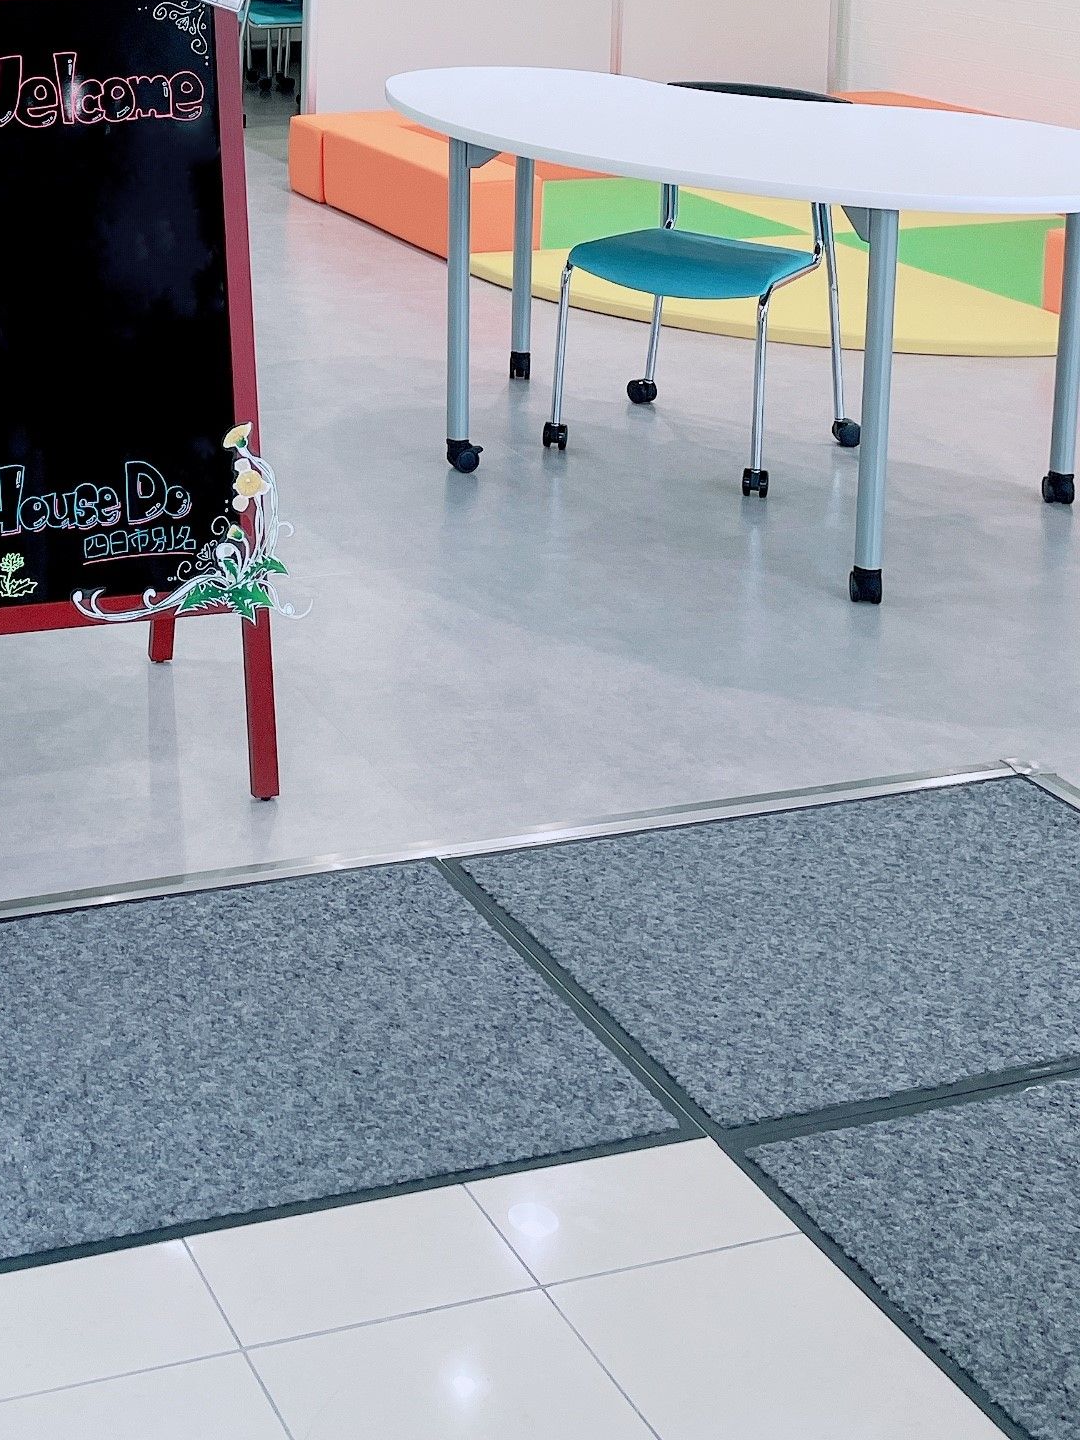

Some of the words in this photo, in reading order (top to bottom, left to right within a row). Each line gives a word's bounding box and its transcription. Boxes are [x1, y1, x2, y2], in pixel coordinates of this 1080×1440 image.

[125, 460, 193, 526] Do
[83, 525, 197, 559] 四日市別名
